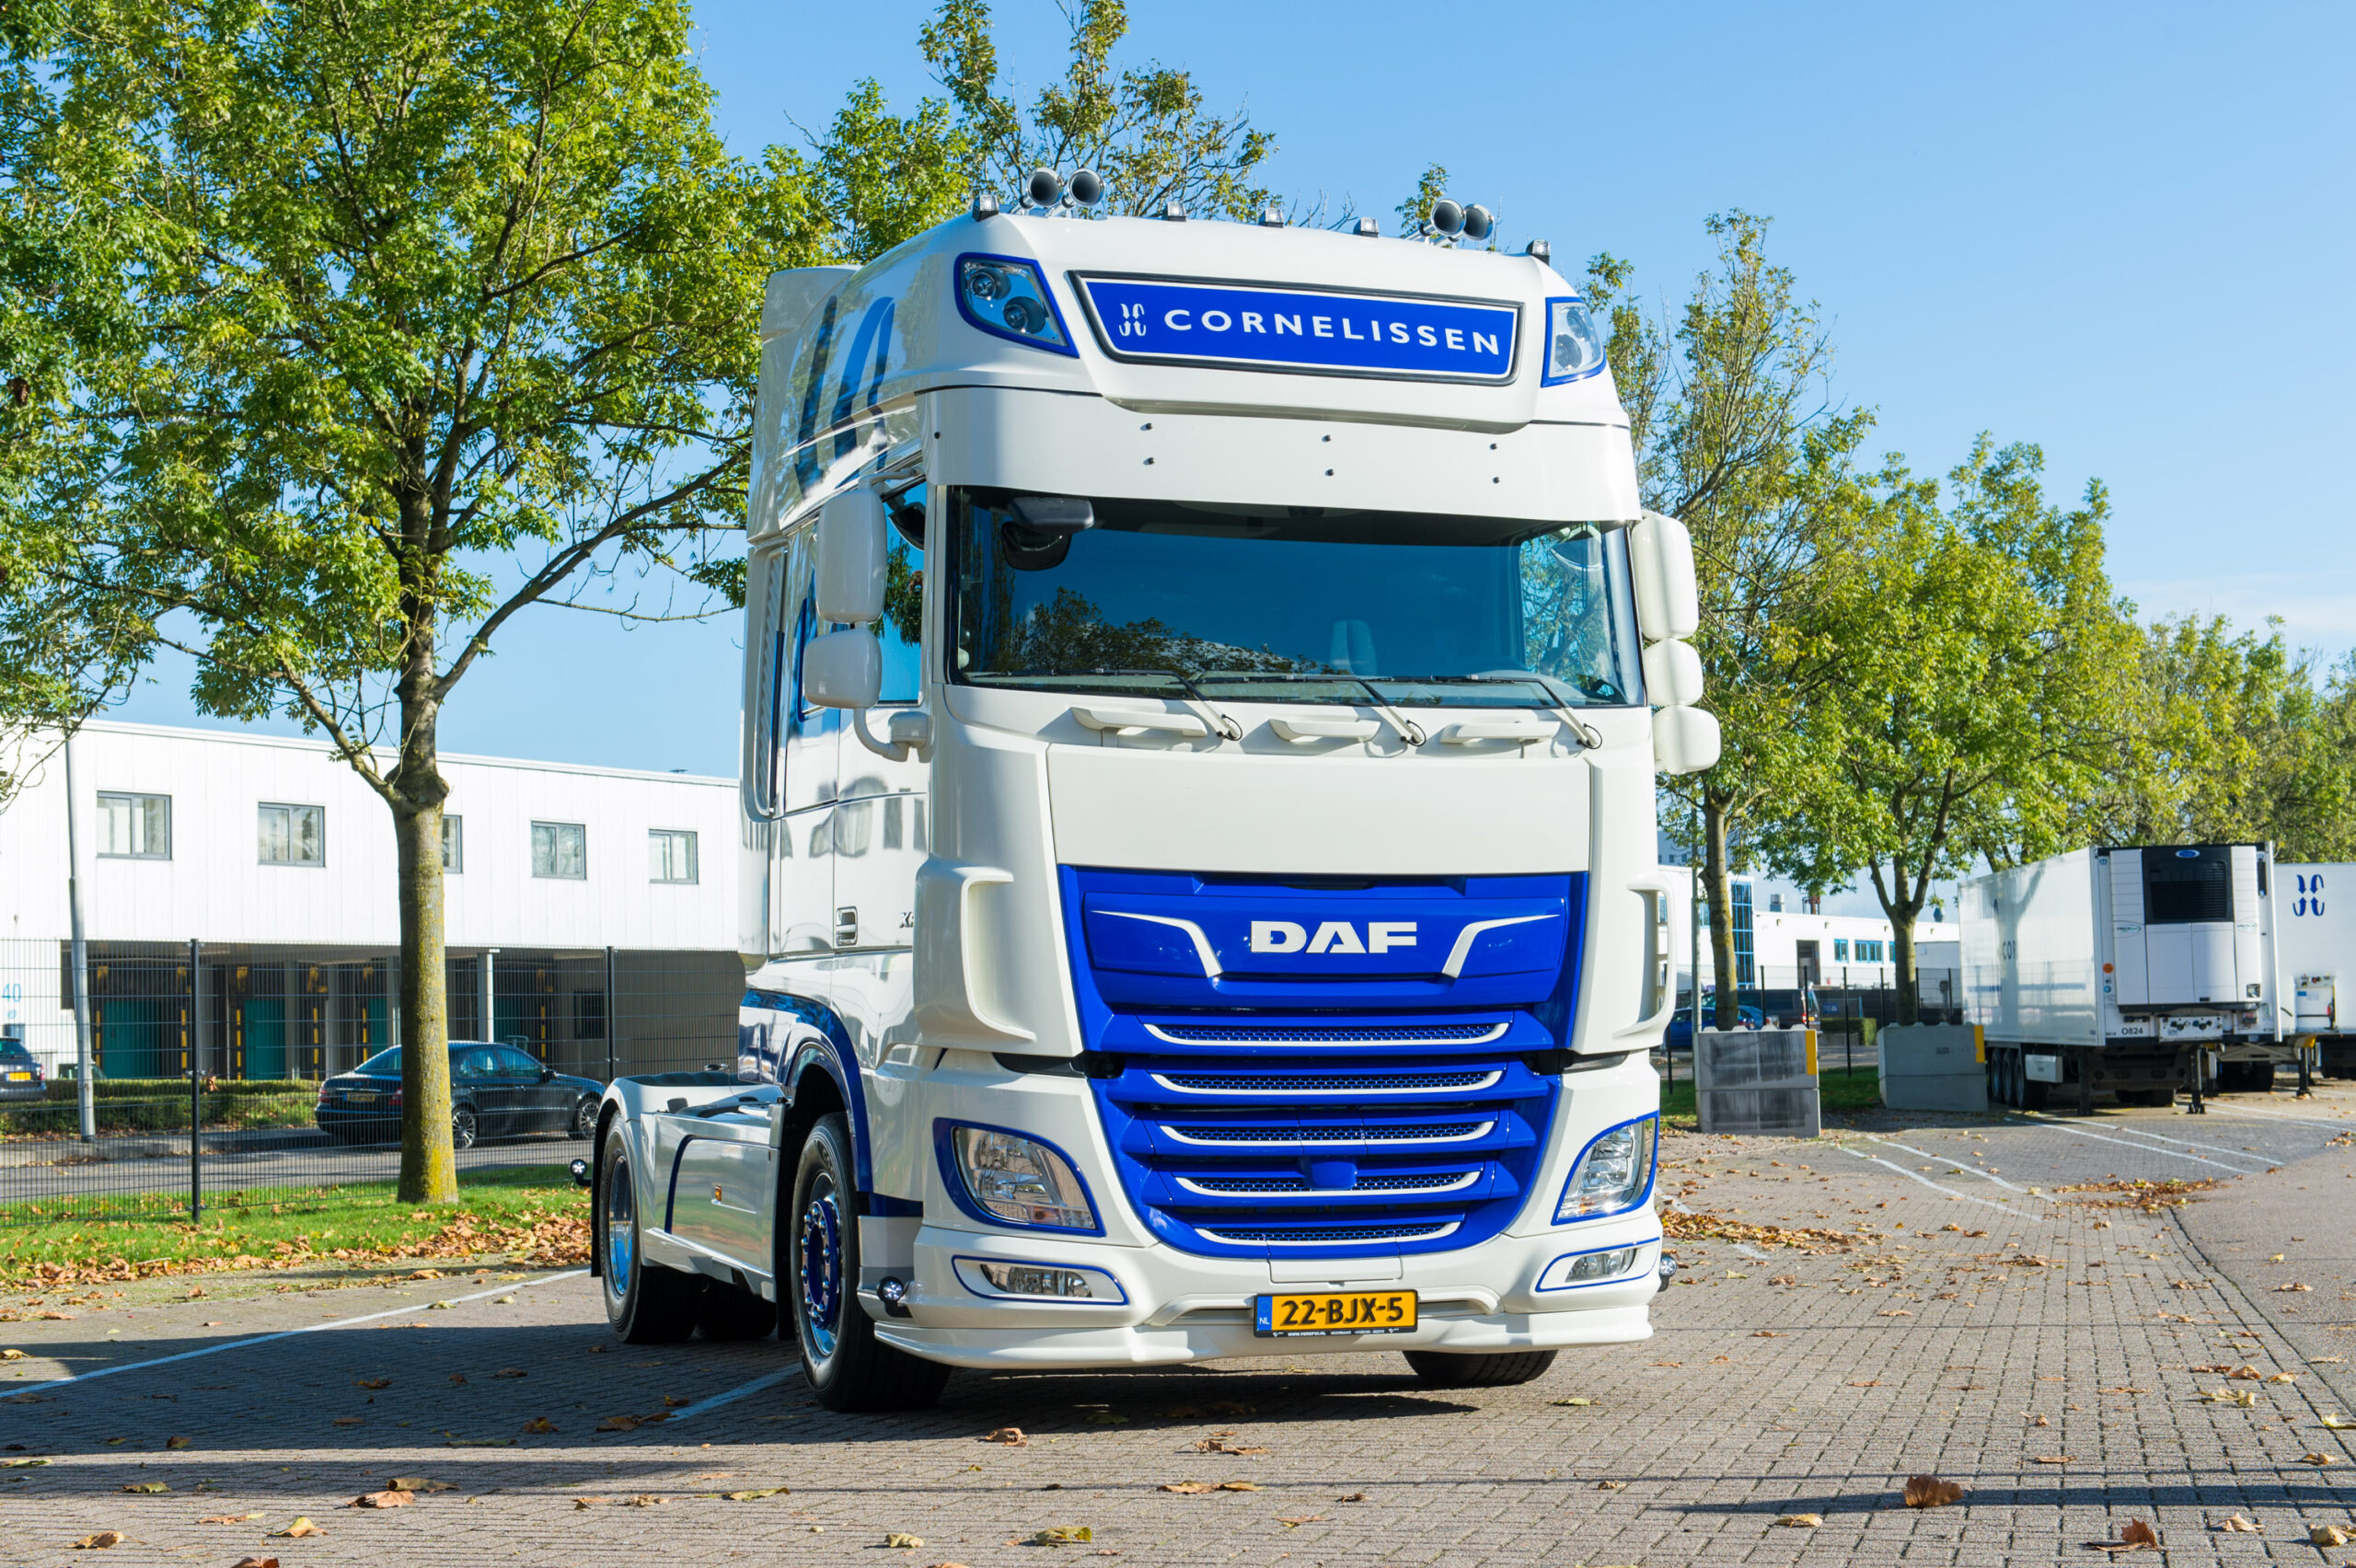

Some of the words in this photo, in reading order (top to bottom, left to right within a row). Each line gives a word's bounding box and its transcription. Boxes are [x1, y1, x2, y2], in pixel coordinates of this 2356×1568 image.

[1164, 309, 1500, 355] CORNELISSEN
[1251, 920, 1417, 953] DAF
[2, 983, 21, 1002] 40
[1259, 1317, 1270, 1325] NL
[1280, 1297, 1403, 1326] 22-BJX-5
